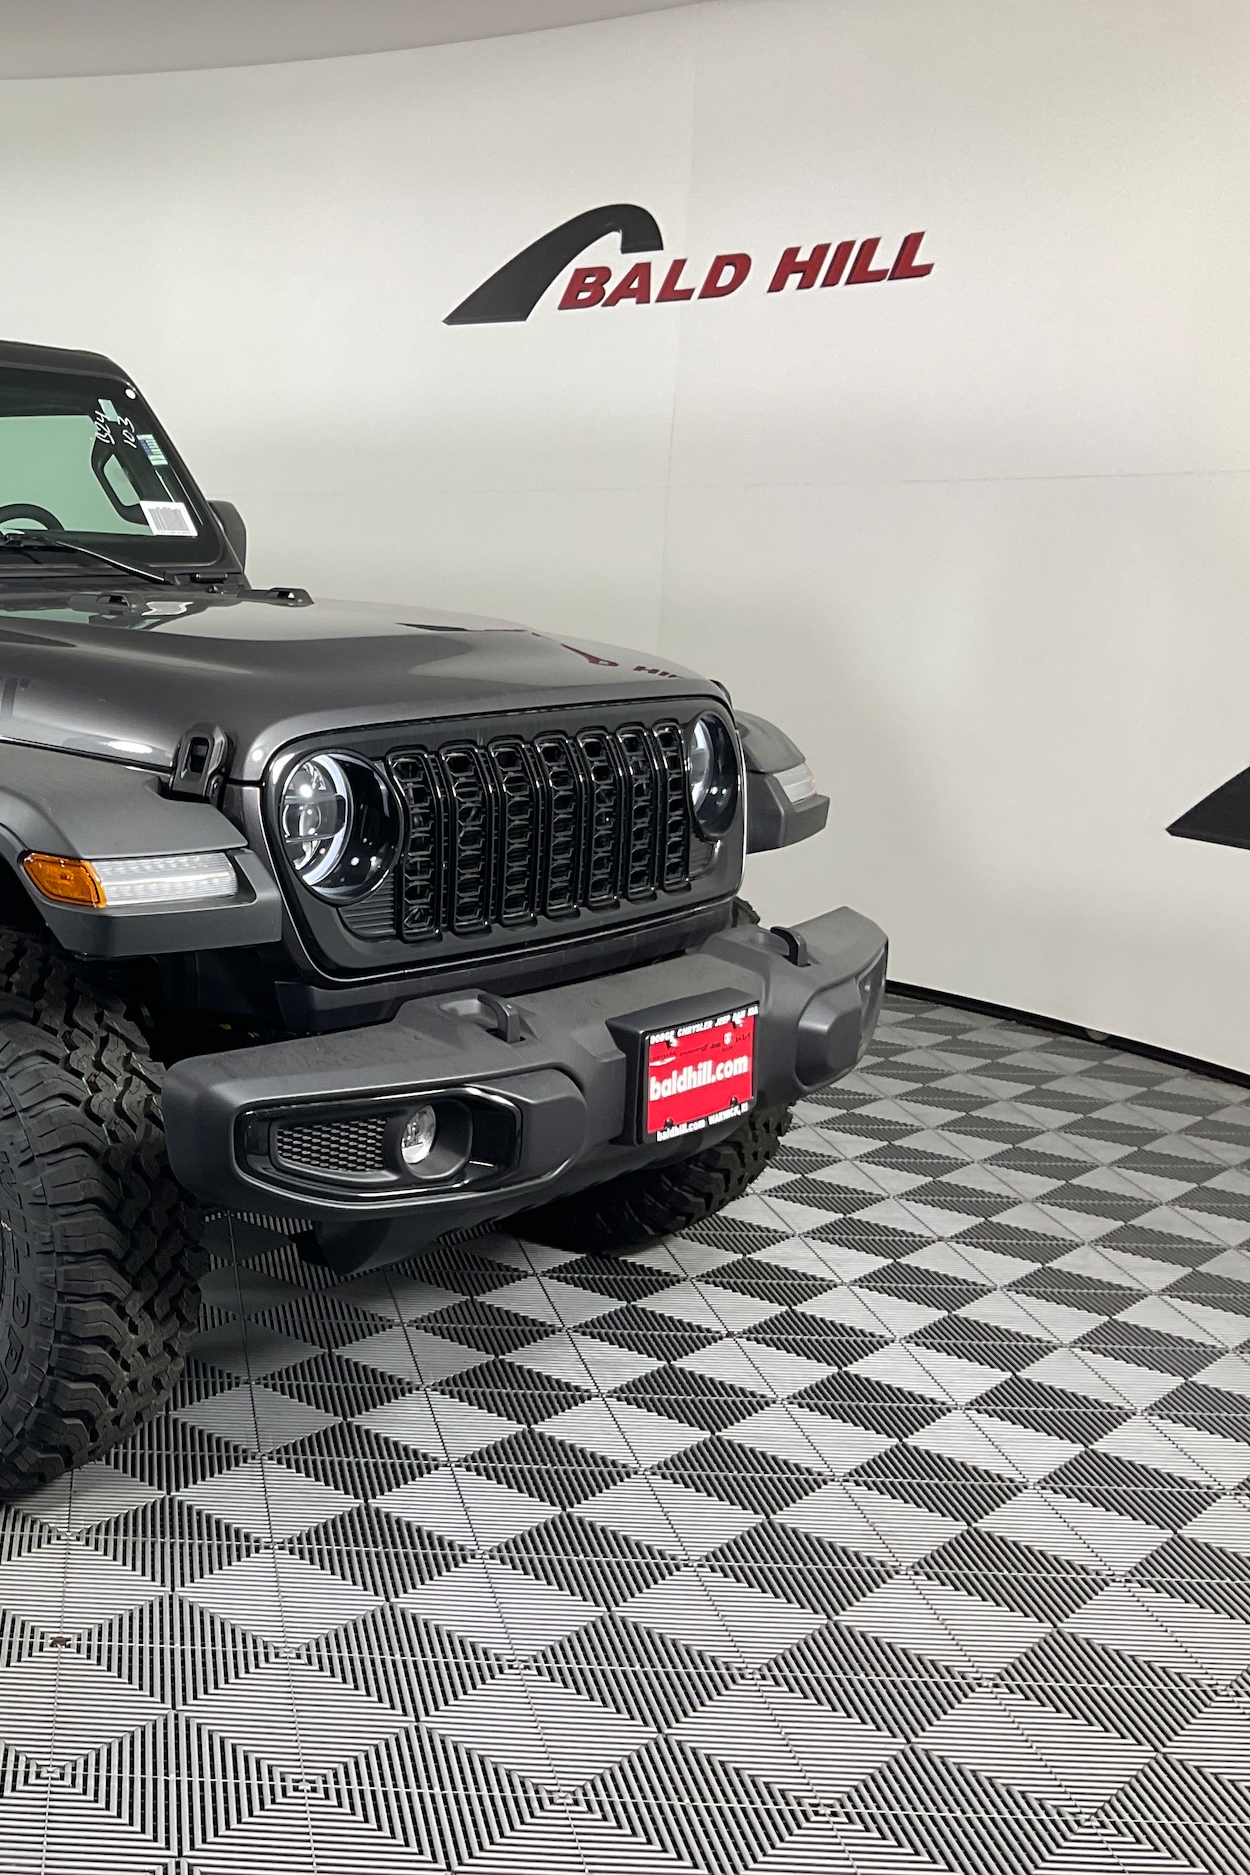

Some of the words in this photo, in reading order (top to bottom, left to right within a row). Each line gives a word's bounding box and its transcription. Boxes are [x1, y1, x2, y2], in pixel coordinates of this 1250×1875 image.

[557, 253, 752, 310] BALD
[766, 231, 935, 293] HILL
[116, 416, 138, 449] 103
[650, 1031, 676, 1045] DODGE
[677, 1020, 713, 1037] CHRYSLER
[714, 1014, 731, 1027] JEEP
[650, 1055, 748, 1101] baldhill.com
[657, 1119, 706, 1142] baldhill.com
